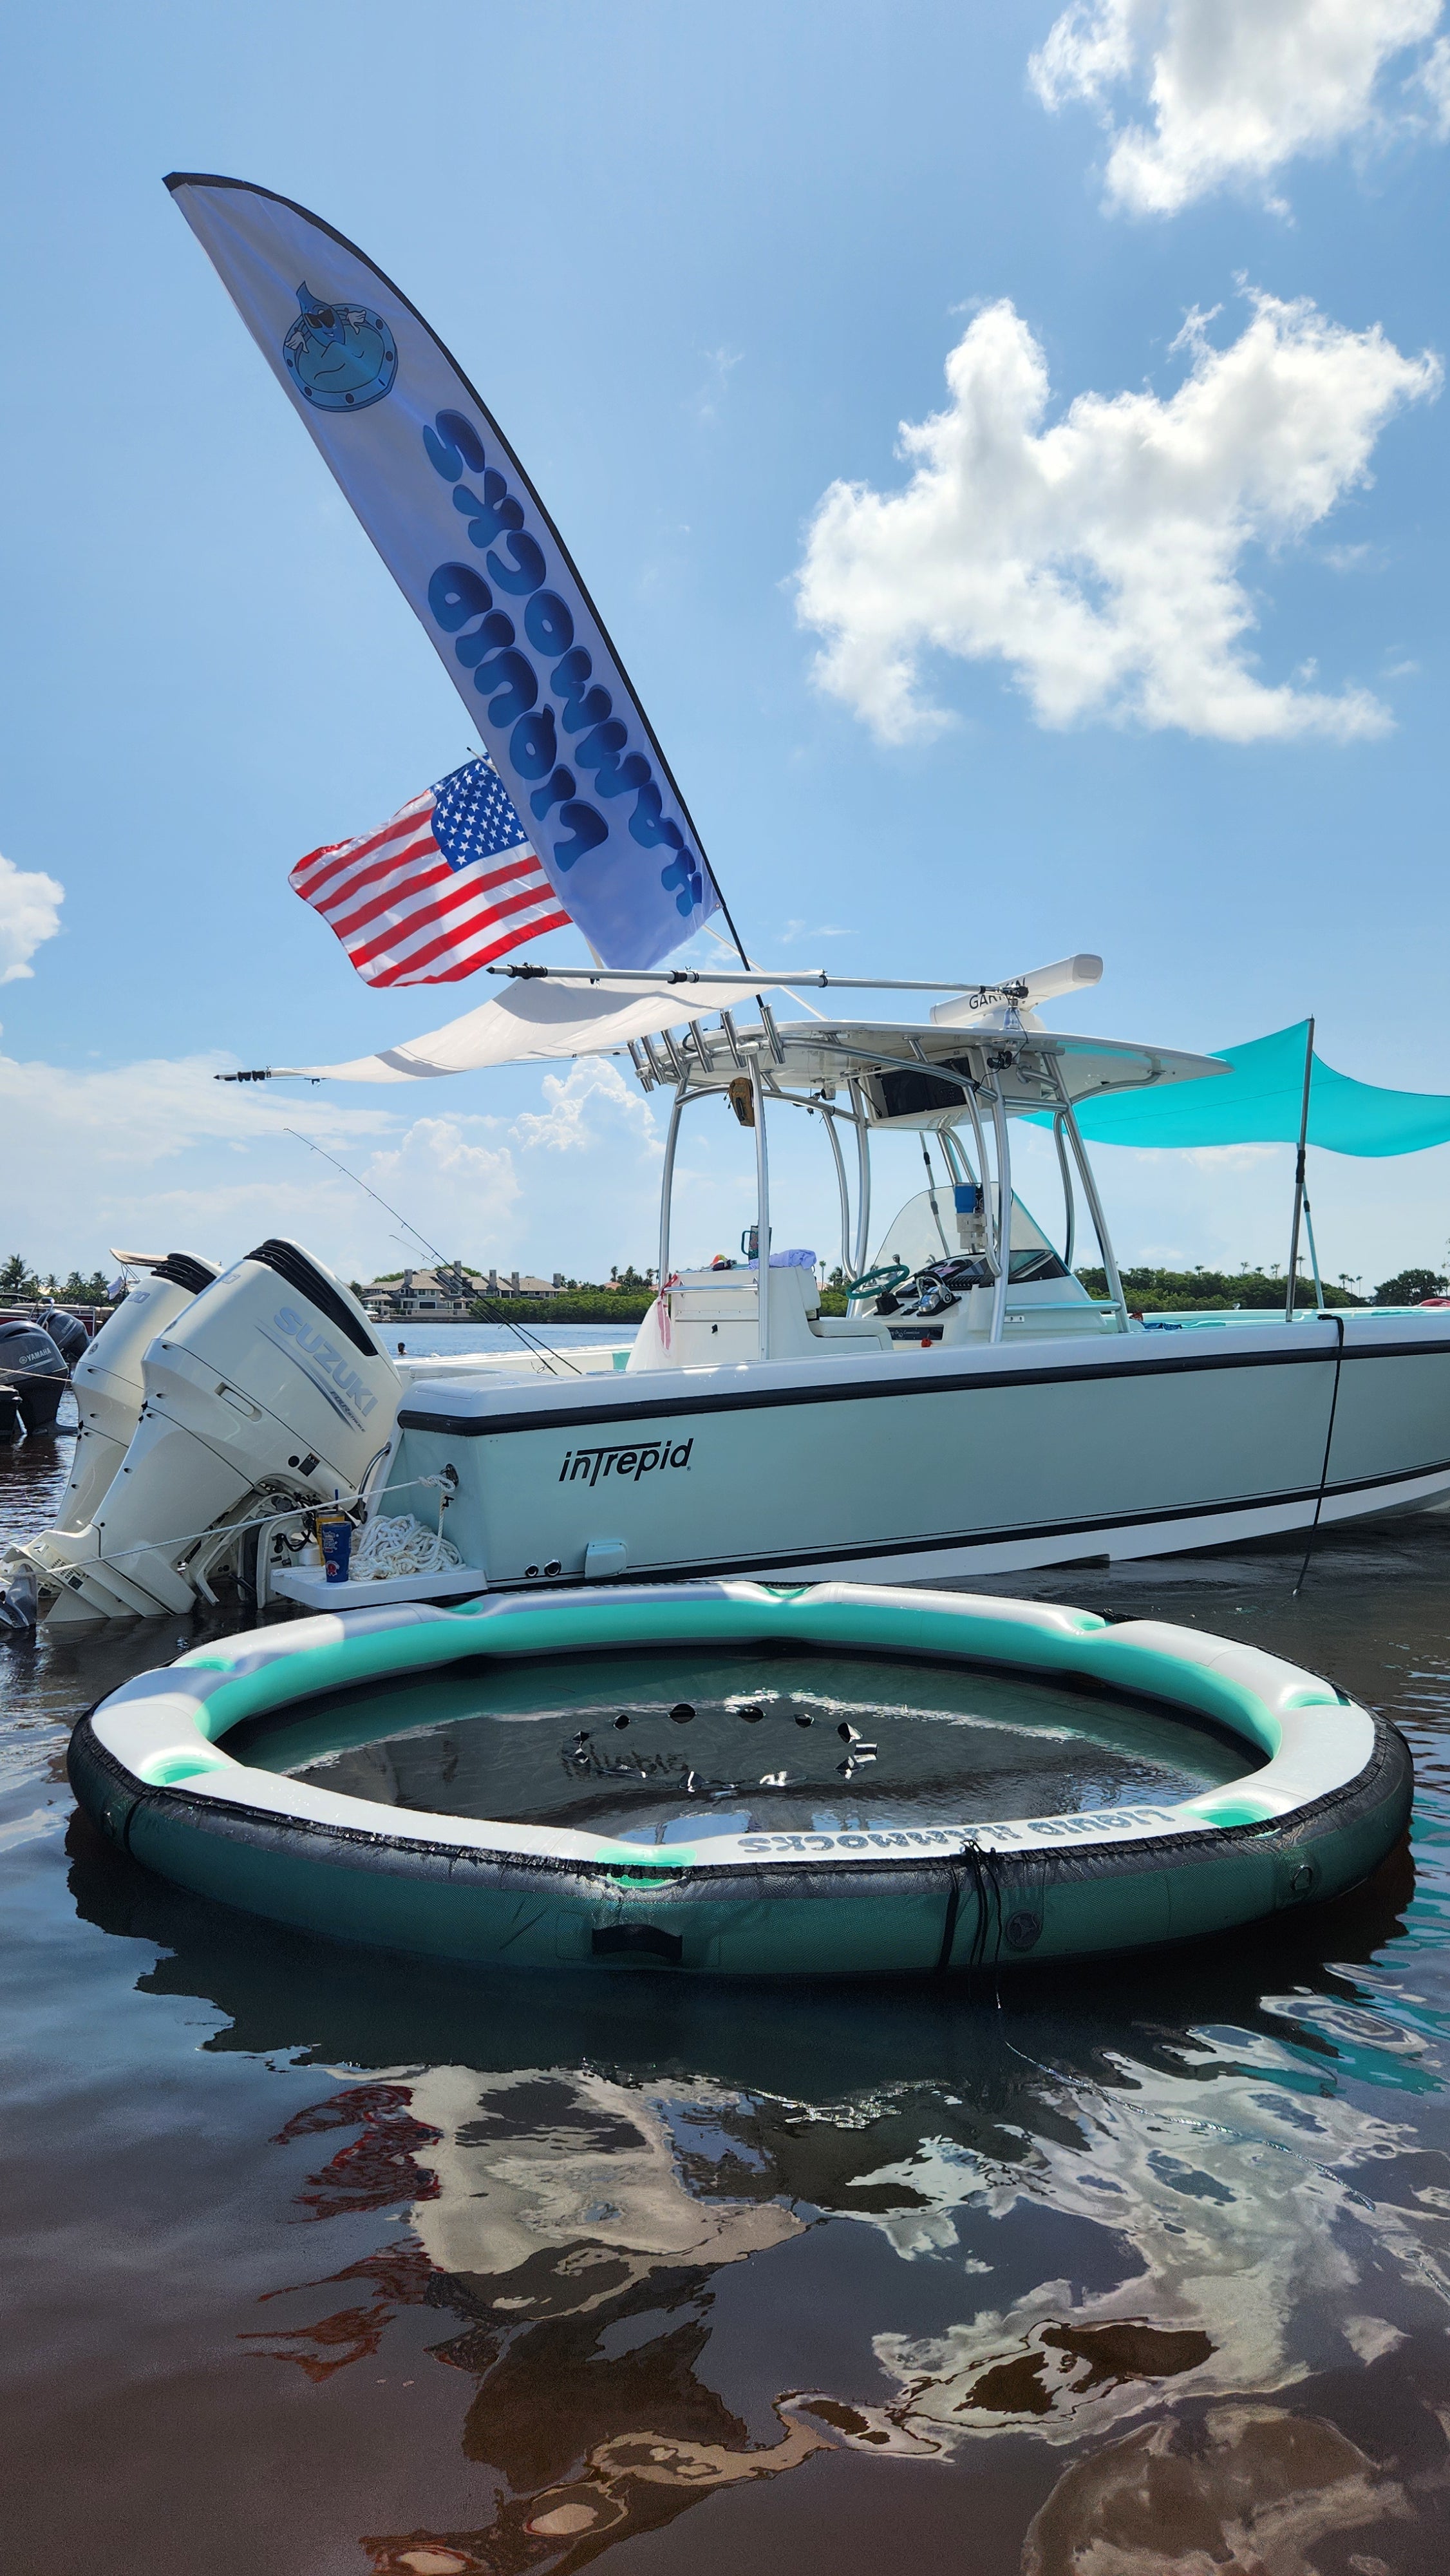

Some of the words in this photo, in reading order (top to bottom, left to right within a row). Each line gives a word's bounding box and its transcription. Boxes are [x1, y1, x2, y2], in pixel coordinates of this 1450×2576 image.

[423, 409, 702, 917] HAMMOCKS
[428, 562, 608, 872] LIQUID
[26, 1347, 52, 1362] YAMAHA
[274, 1307, 379, 1417] SUZUKI
[737, 1824, 1023, 1853] HAMMOCKS
[1028, 1808, 1176, 1836] LIQUID
